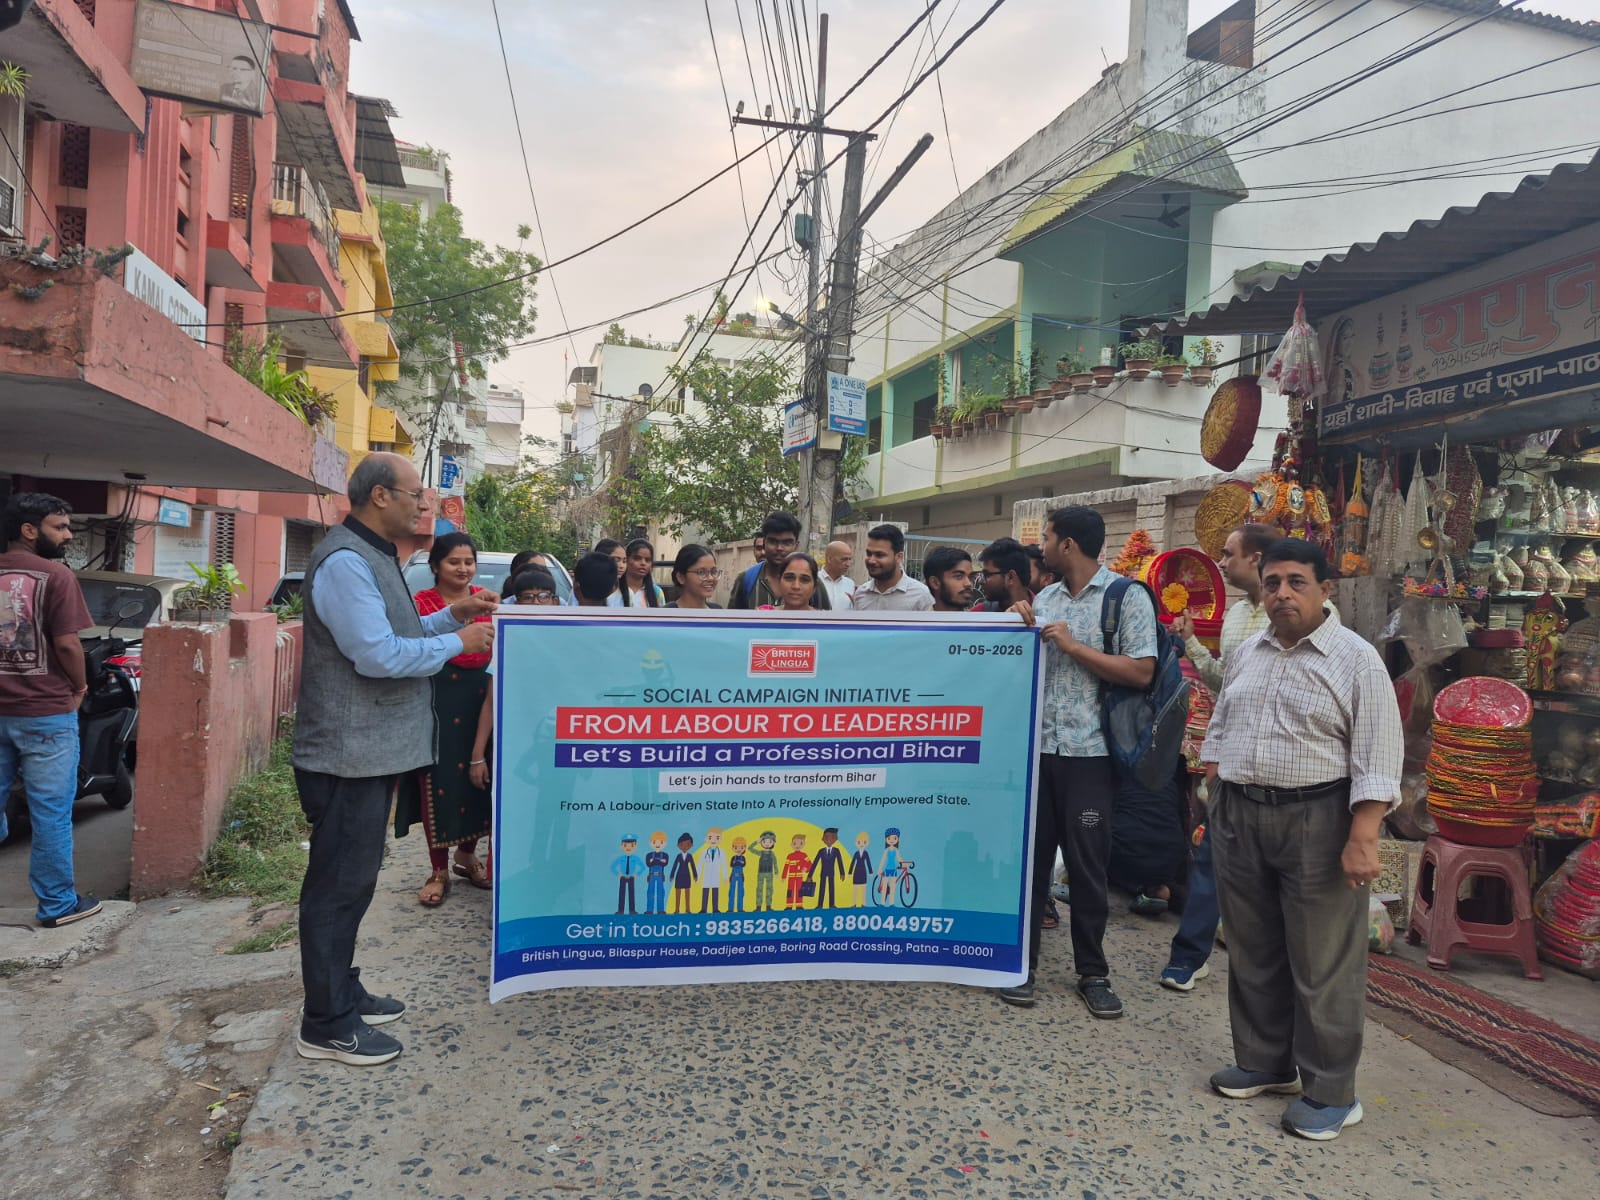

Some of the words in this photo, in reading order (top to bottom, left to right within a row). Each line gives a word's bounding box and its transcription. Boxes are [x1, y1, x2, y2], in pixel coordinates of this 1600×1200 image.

[134, 268, 164, 312] KAMAL
[1463, 371, 1494, 398] एवं
[771, 649, 811, 658] BRITISH
[949, 644, 1023, 656] 01-05-2026
[771, 659, 809, 668] LINGUA
[643, 688, 712, 703] SOCIAL
[718, 688, 819, 703] CAMPAIGN
[825, 688, 911, 703] INITIATIVE
[569, 714, 652, 734] FROM
[661, 713, 769, 734] LABOUR
[778, 713, 814, 733] TO
[822, 712, 972, 732] LEADERSHIP
[571, 746, 632, 763] Let's
[641, 745, 706, 762] Build
[715, 749, 732, 761] a
[740, 743, 894, 761] Professional
[903, 742, 966, 758] Bihar
[669, 775, 697, 786] Let's
[700, 774, 723, 789] join
[726, 773, 765, 785] hands
[768, 773, 781, 784] to
[784, 772, 843, 784] transform
[846, 771, 876, 782] Bihar
[560, 800, 594, 811] From
[598, 801, 606, 811] A
[610, 800, 702, 811] Labour-driven
[706, 800, 739, 810] State
[741, 798, 764, 809] Into
[768, 799, 776, 809] A
[780, 796, 862, 809] Professionally
[865, 795, 933, 808] Empowered
[937, 794, 971, 806] State.
[566, 923, 602, 939] Get
[608, 922, 625, 938] in
[632, 921, 690, 938] touch
[705, 916, 828, 935] 9835266418,
[833, 915, 954, 933] 8800449757
[522, 950, 560, 963] British
[563, 948, 606, 961] Lingua,
[608, 947, 657, 960] Bilaspur
[659, 946, 699, 957] House,
[702, 945, 746, 957] Dadijee
[748, 944, 777, 954] Lane,
[780, 943, 816, 955] Boring
[819, 941, 848, 951] Road
[851, 941, 903, 954] Crossing,
[906, 943, 939, 953] Patna
[953, 944, 994, 957] 800001
